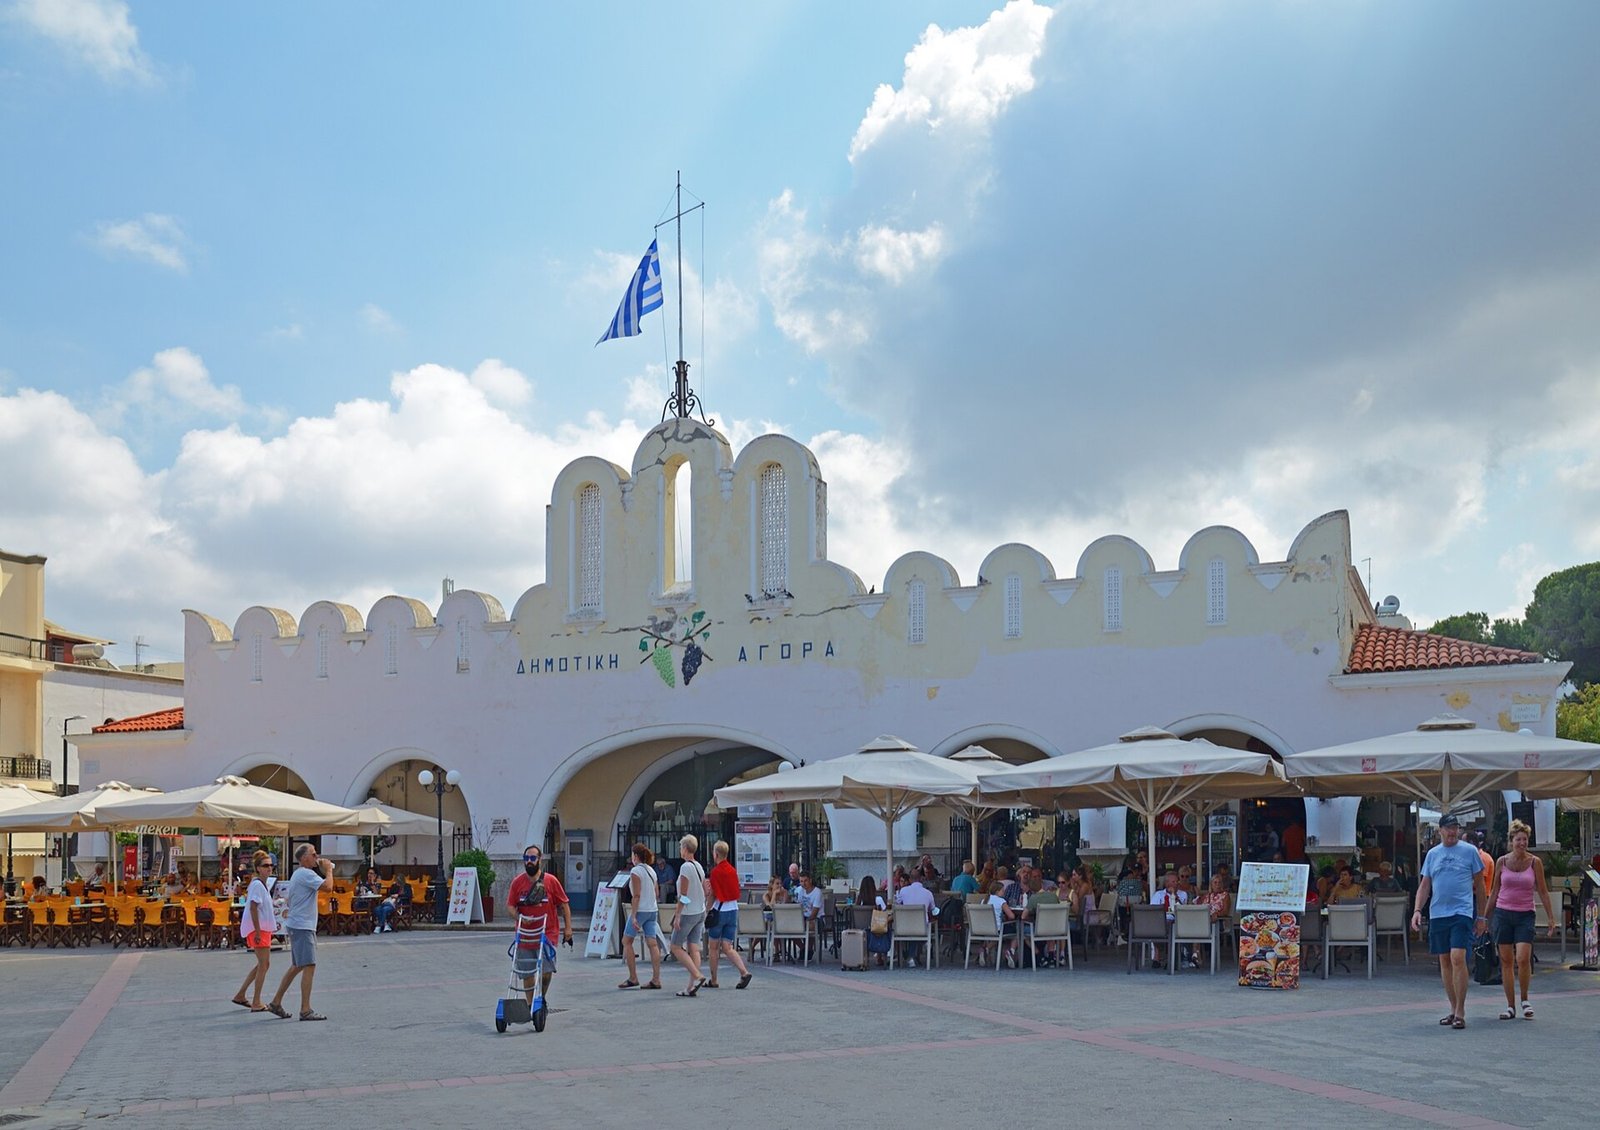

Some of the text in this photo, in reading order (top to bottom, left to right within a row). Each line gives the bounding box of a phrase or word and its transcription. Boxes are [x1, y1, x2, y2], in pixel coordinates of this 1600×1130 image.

[517, 640, 835, 674] ΔΗΜΟΤΙΚΗ ΑΓΟΡΑ
[1162, 812, 1181, 827] illy
